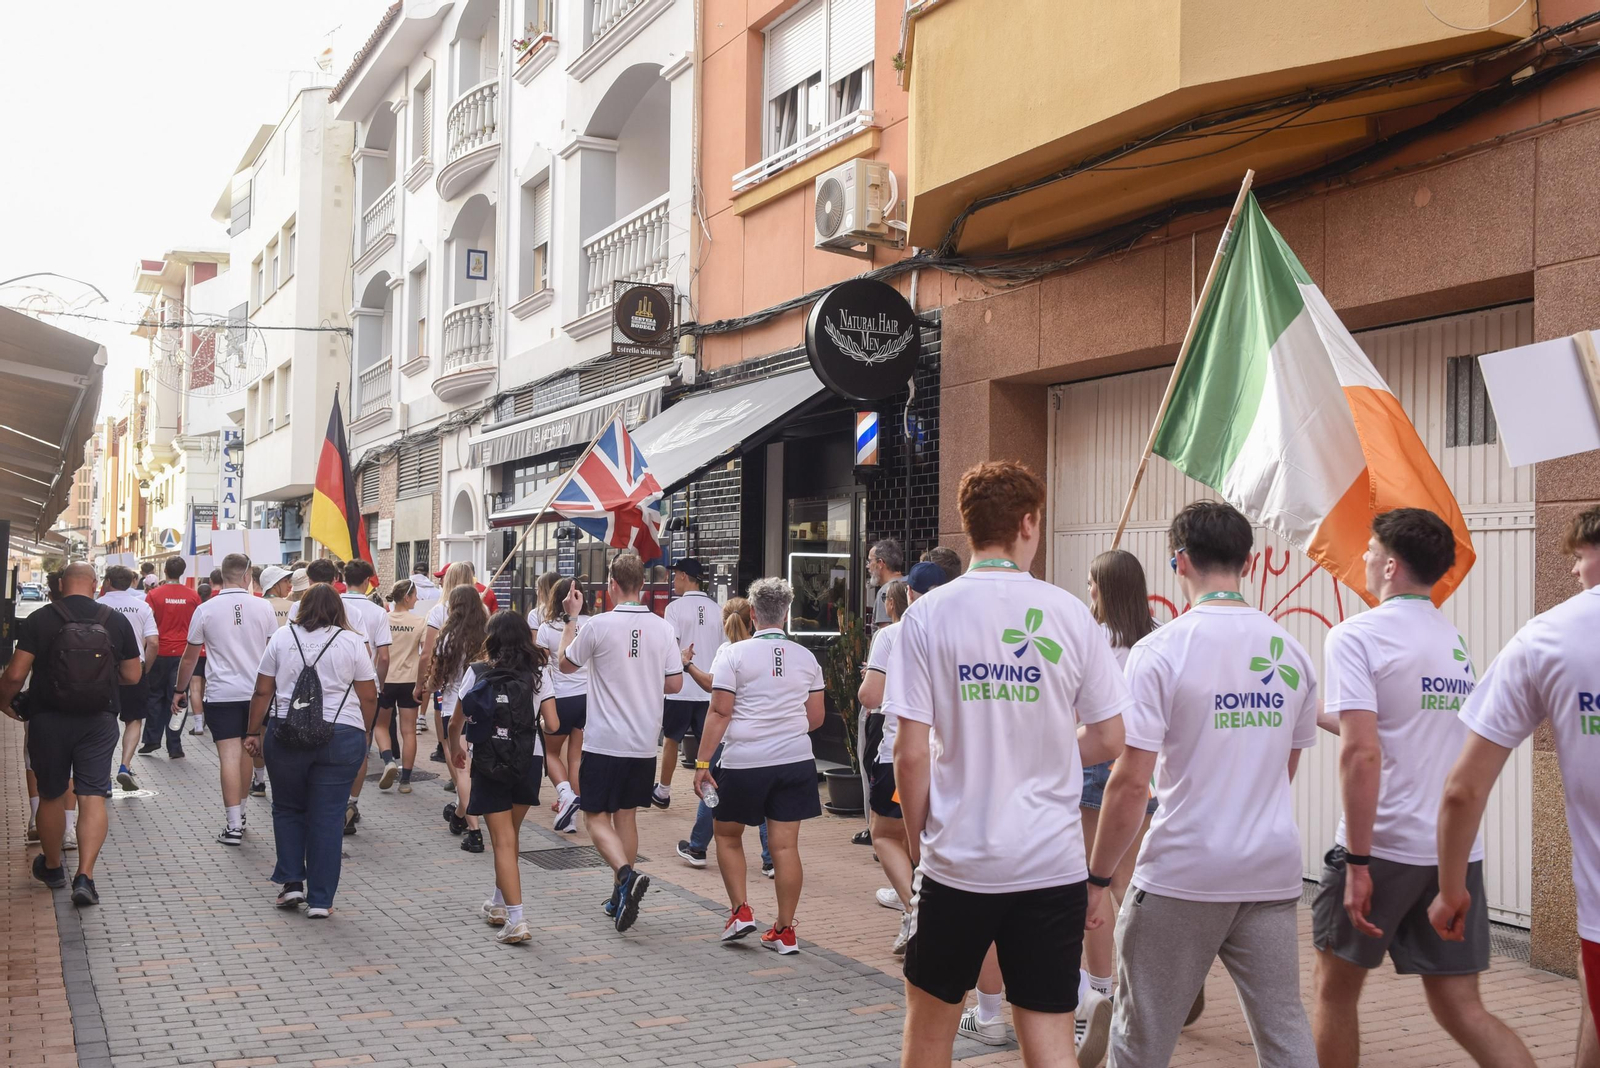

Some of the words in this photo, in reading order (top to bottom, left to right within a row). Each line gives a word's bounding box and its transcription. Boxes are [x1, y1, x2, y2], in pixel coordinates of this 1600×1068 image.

[616, 345, 639, 354] Estrella
[640, 347, 661, 356] Galicia
[223, 430, 238, 519] HSTAL
[234, 604, 242, 626] GBR
[631, 629, 639, 658] GBR
[774, 647, 783, 677] GBR
[958, 663, 1042, 683] ROWING
[960, 682, 1040, 702] IRELAND
[1215, 692, 1284, 710] ROWING
[1421, 694, 1467, 712] IRELA
[1214, 711, 1283, 729] IRELAND
